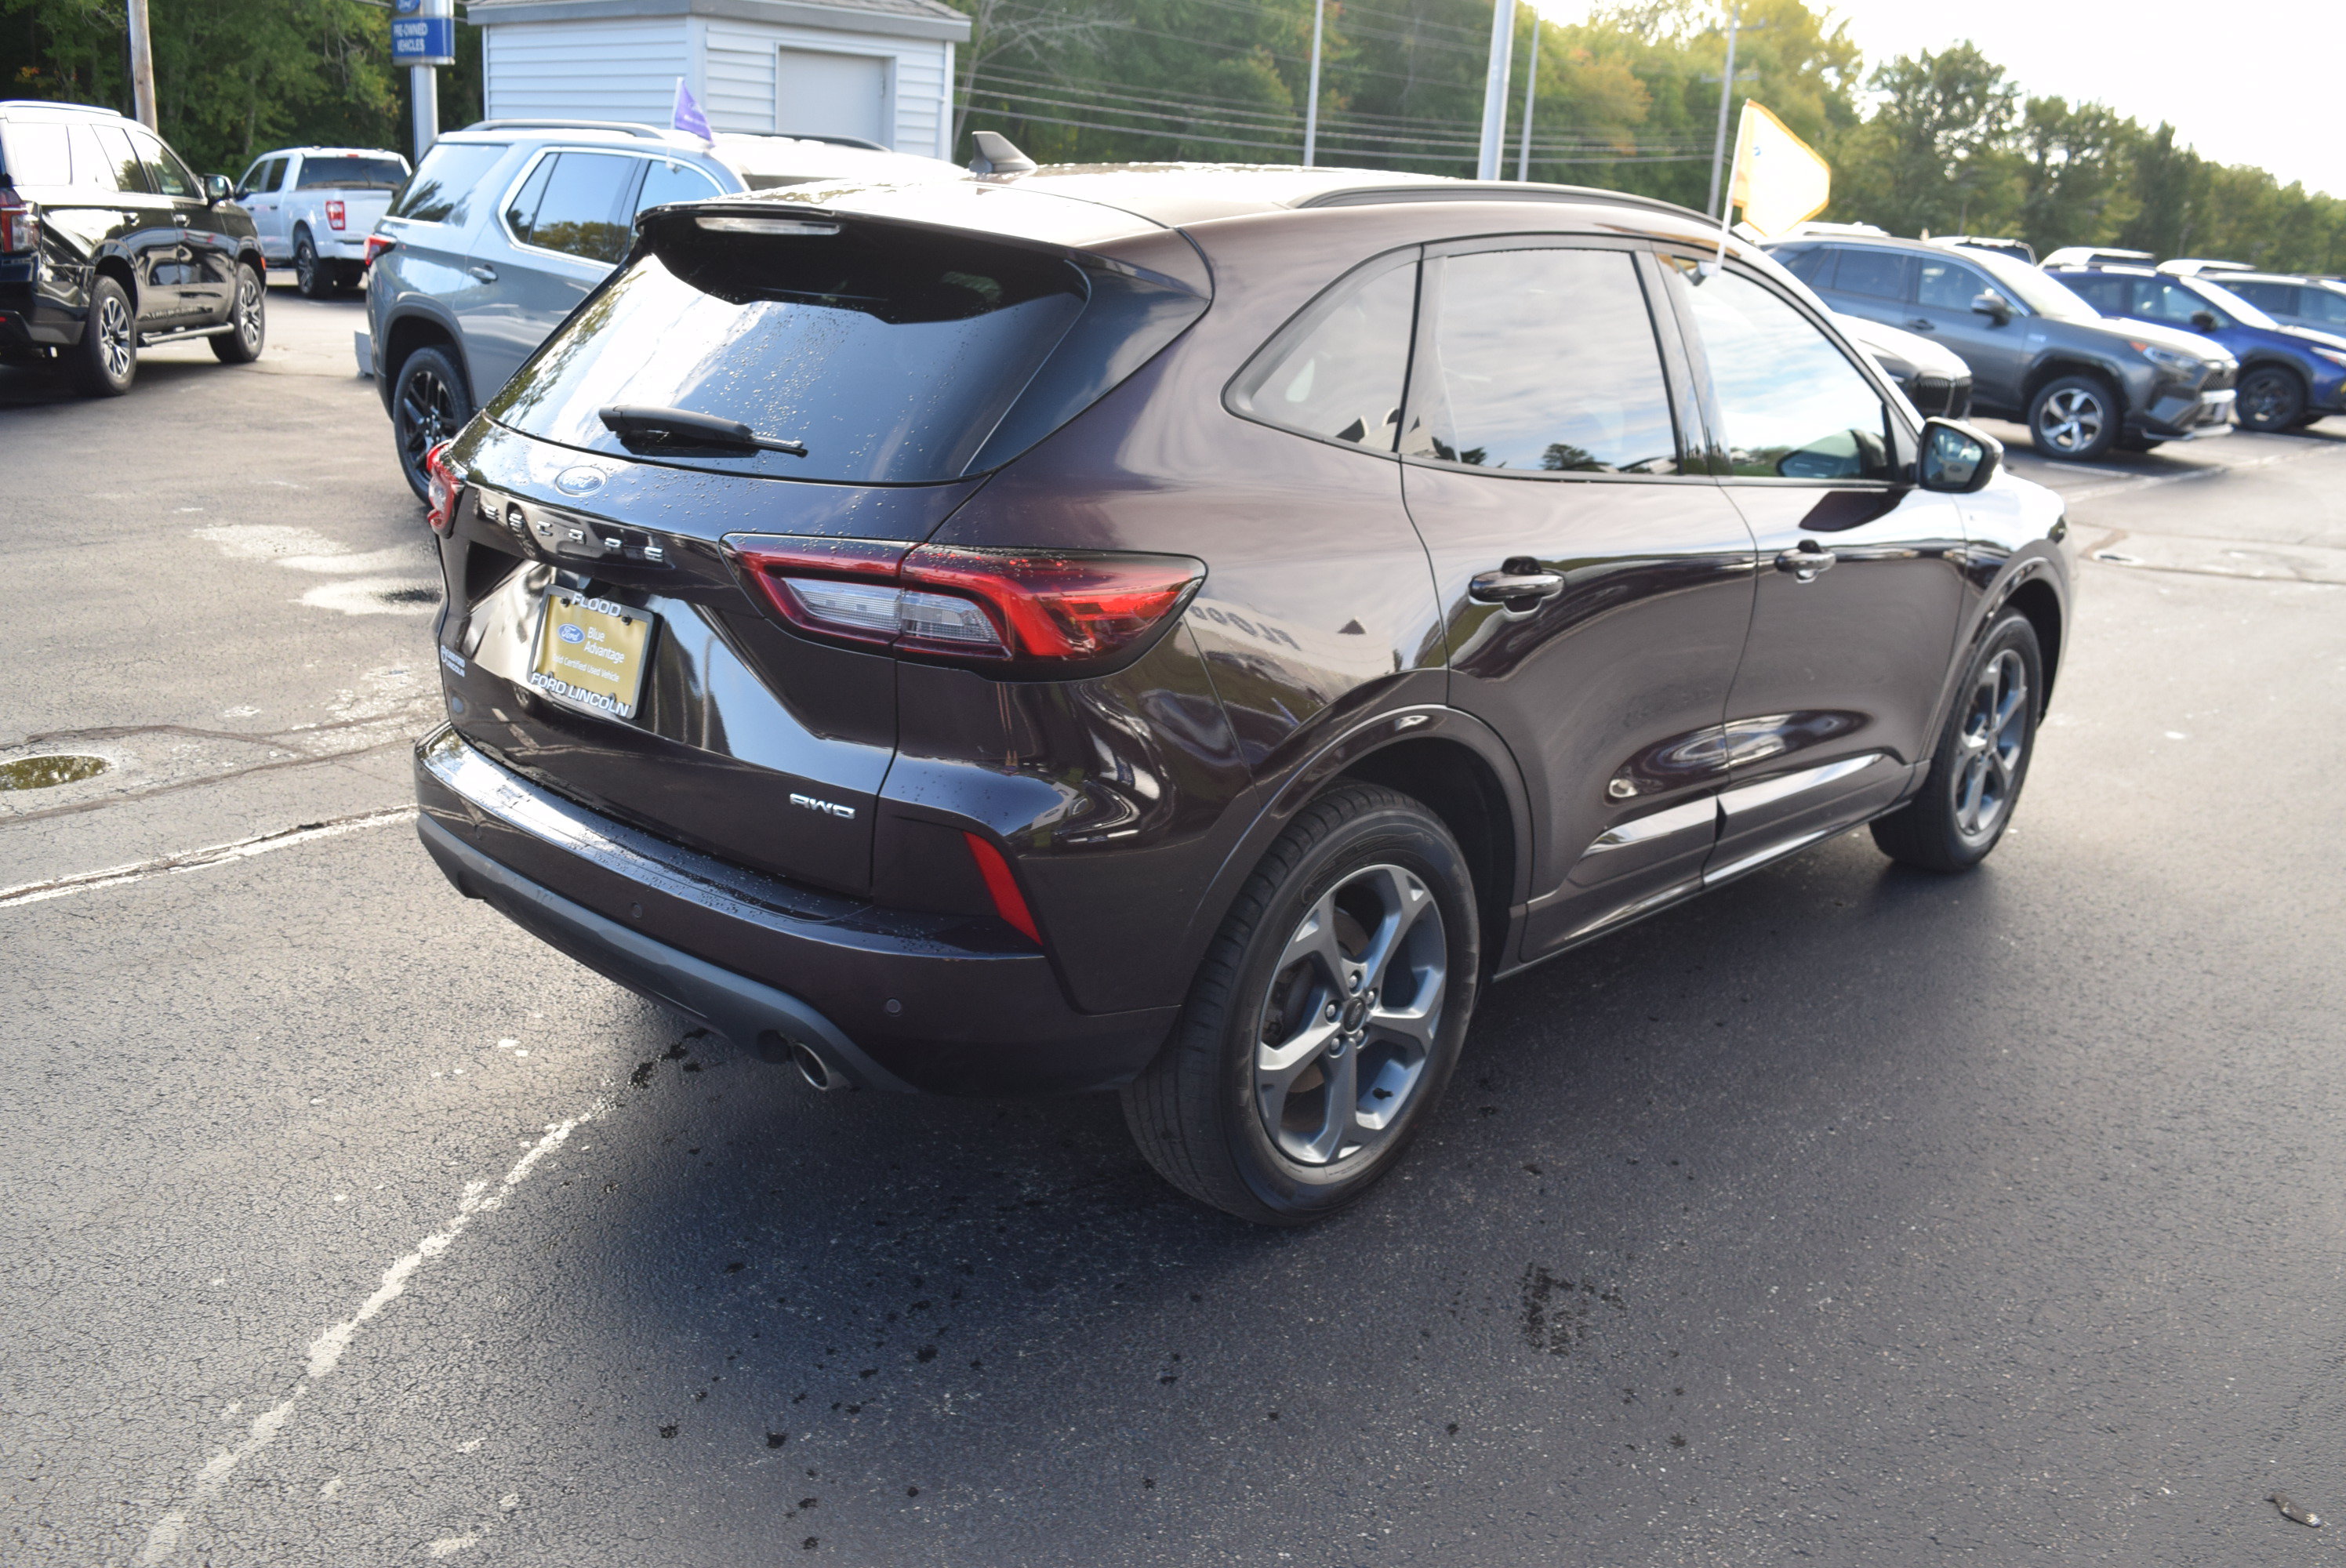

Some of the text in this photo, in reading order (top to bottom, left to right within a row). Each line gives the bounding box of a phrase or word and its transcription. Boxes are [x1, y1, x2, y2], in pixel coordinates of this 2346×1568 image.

[394, 23, 428, 38] PRE-OWNED
[397, 38, 425, 53] VEHICLES
[485, 505, 664, 562] ESCAPE
[572, 593, 622, 618] FLOOD
[560, 626, 581, 642] Ford
[587, 626, 605, 642] Blue
[583, 641, 625, 664] Advantage
[530, 673, 630, 717] FORD LINCOLN
[790, 793, 855, 819] AWD
